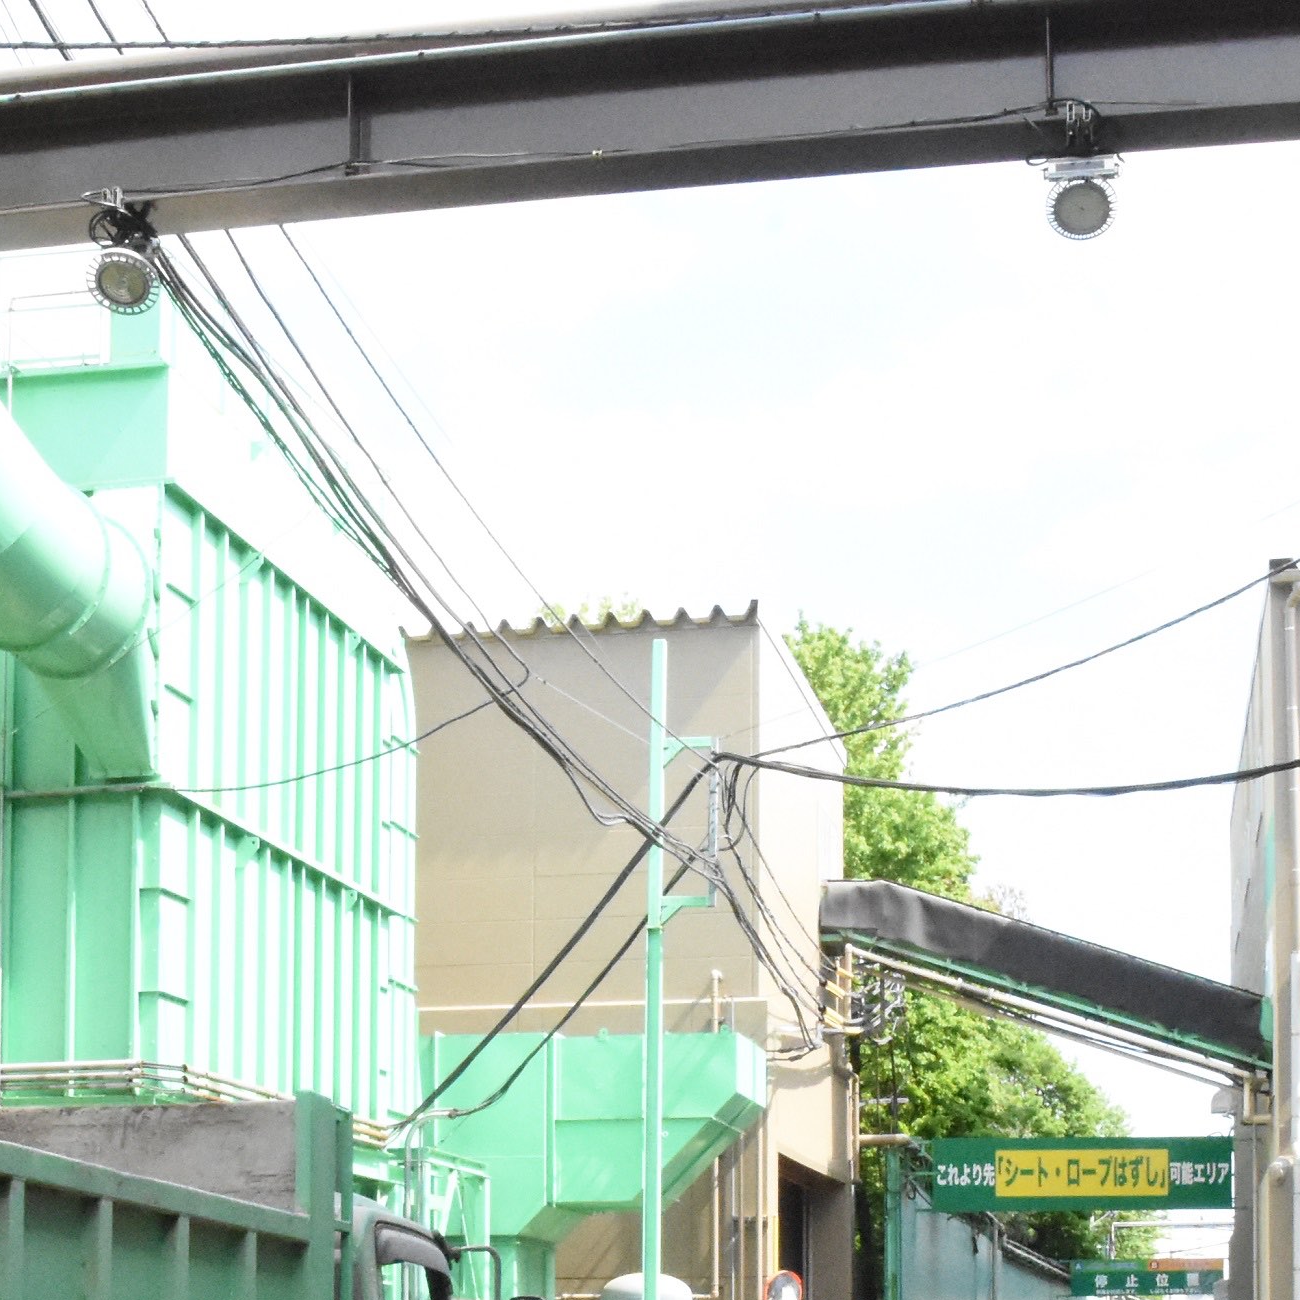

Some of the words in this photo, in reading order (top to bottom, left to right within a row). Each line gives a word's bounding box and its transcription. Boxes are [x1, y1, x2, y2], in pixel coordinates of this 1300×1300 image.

[937, 1163, 995, 1185] これより先
[1169, 1162, 1229, 1185] 可能エリア
